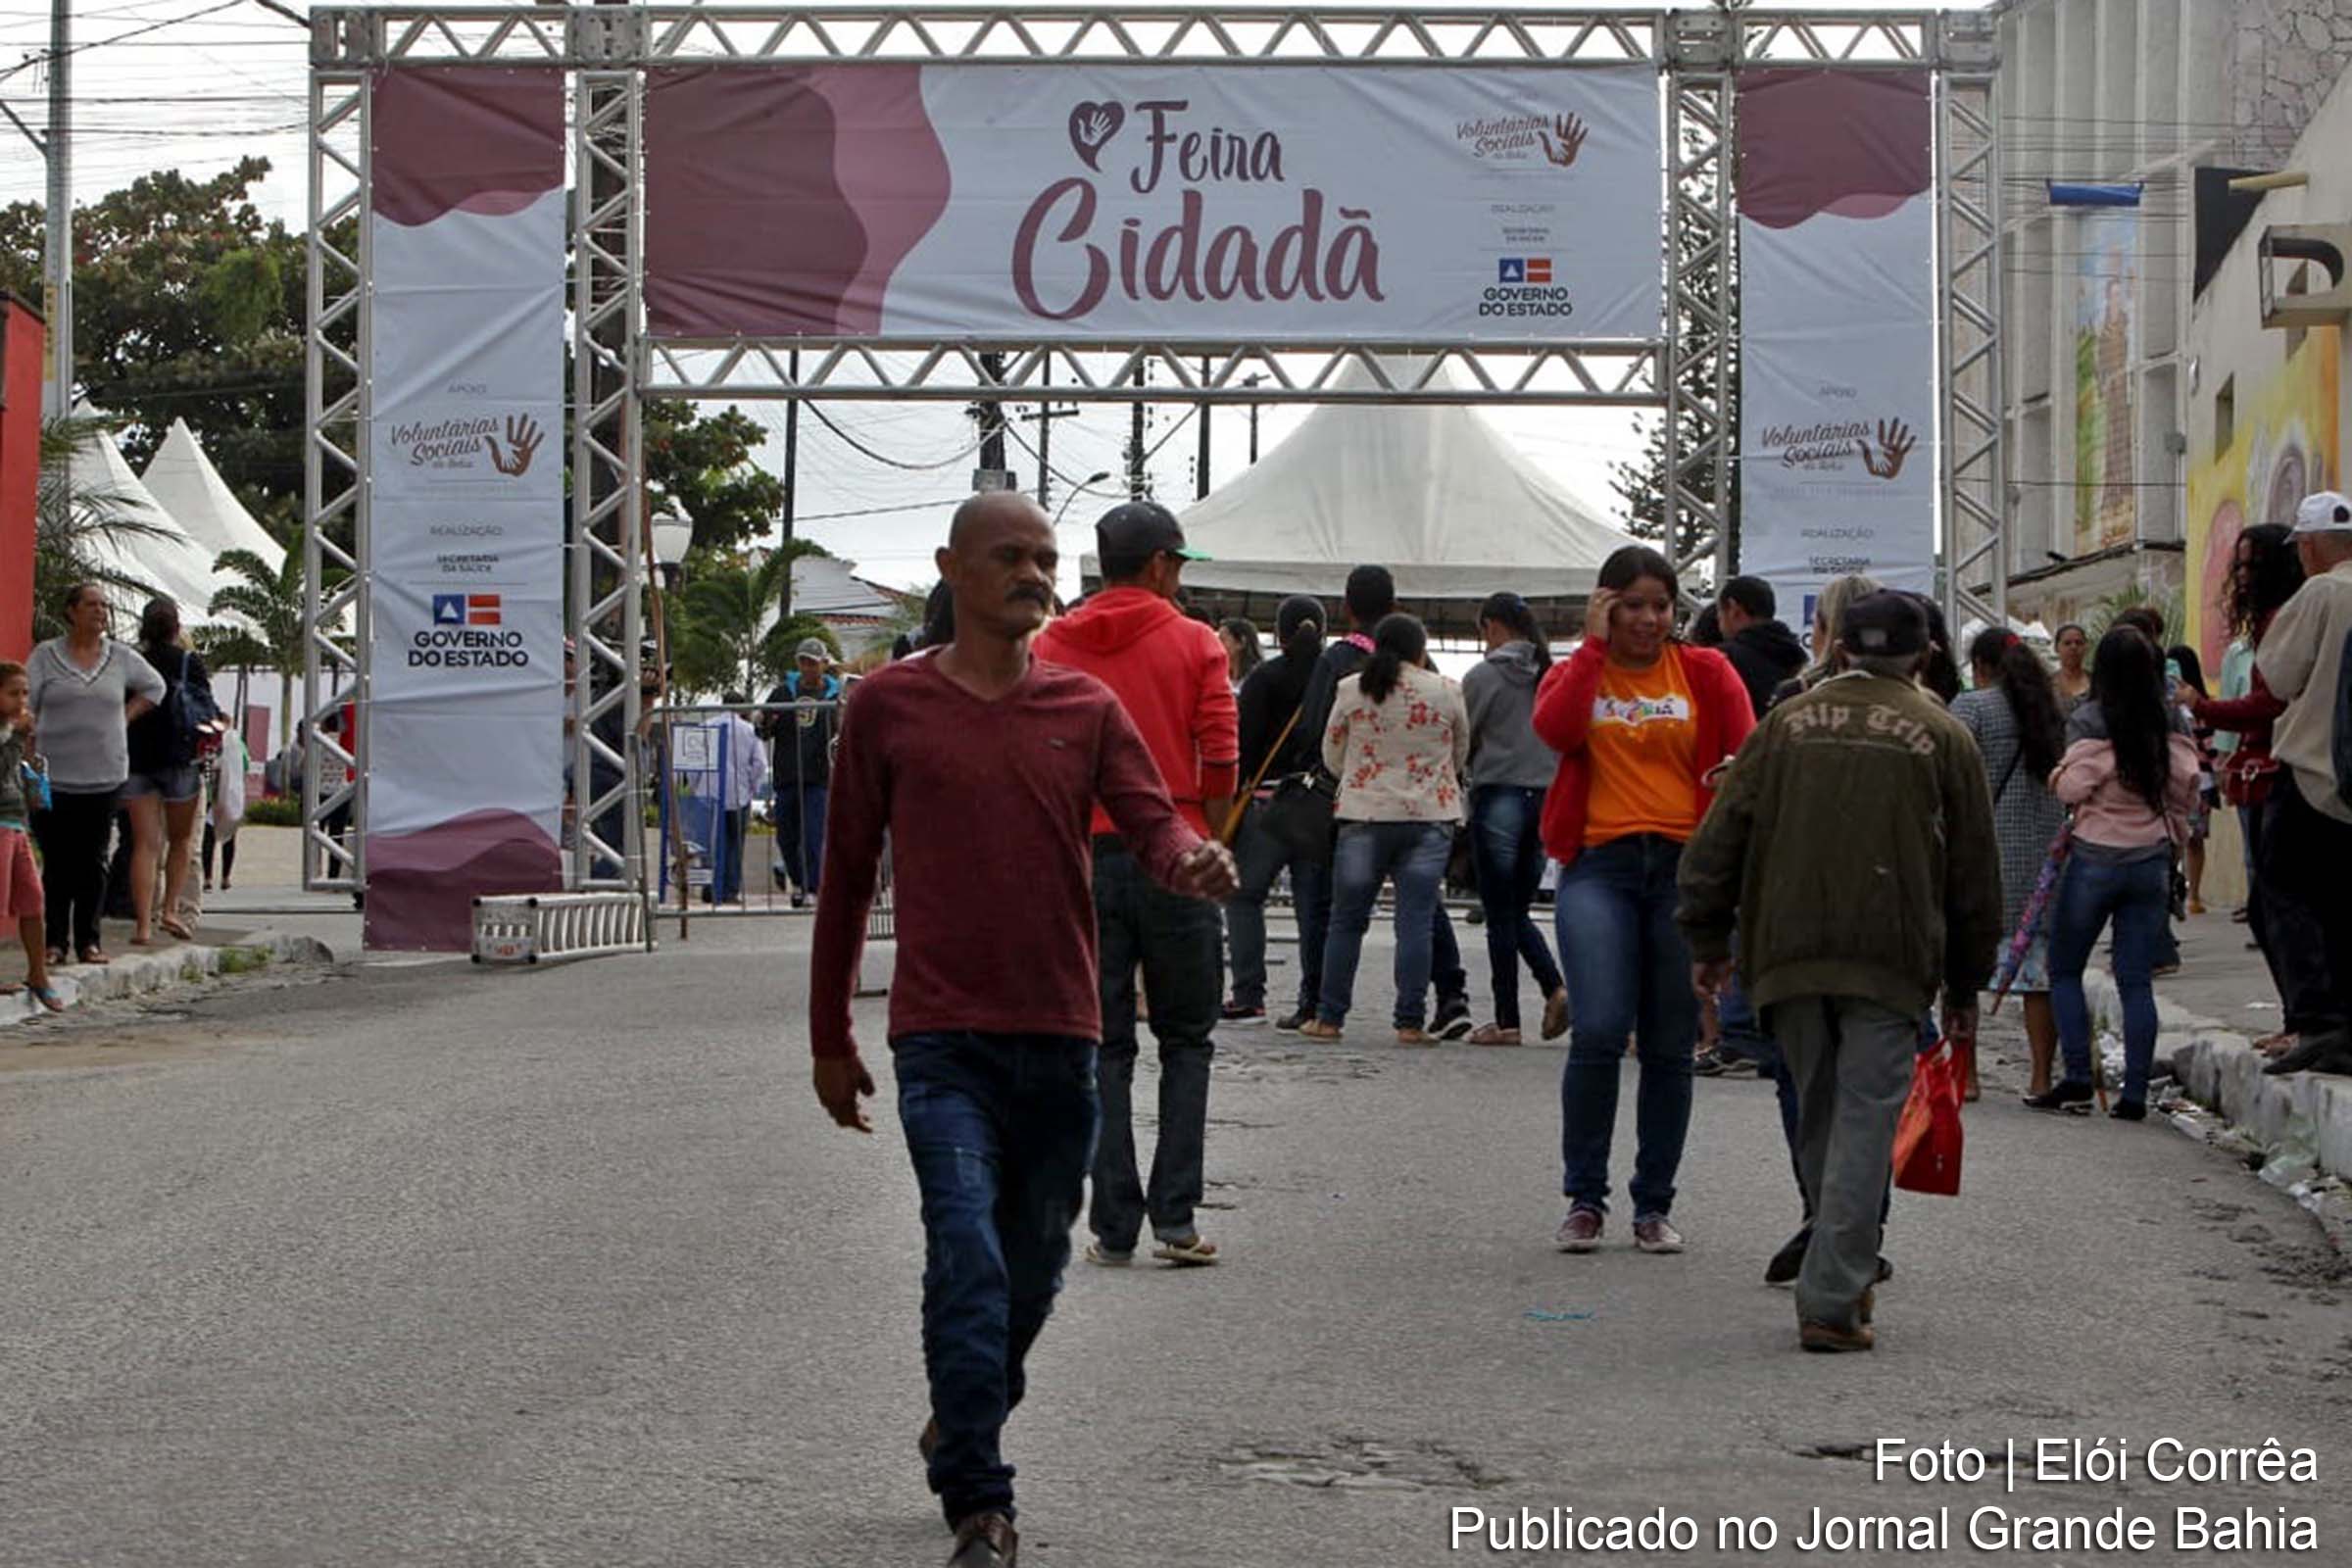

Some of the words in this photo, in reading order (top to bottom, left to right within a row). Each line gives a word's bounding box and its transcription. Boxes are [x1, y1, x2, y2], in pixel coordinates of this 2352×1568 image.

[1130, 99, 1286, 193] Feira
[1474, 131, 1536, 158] Sociais
[1011, 177, 1386, 320] Cidadã
[1483, 287, 1569, 302] GOVERNO
[1479, 303, 1505, 317] DO
[1507, 303, 1573, 317] ESTADO
[391, 416, 500, 445] Voluntárias
[1761, 420, 1873, 447] Voluntárias
[411, 437, 482, 466] Sociais
[1782, 440, 1855, 469] Sociais
[414, 630, 522, 650] GOVERNO
[408, 650, 442, 668] DO
[444, 650, 529, 668] ESTADO
